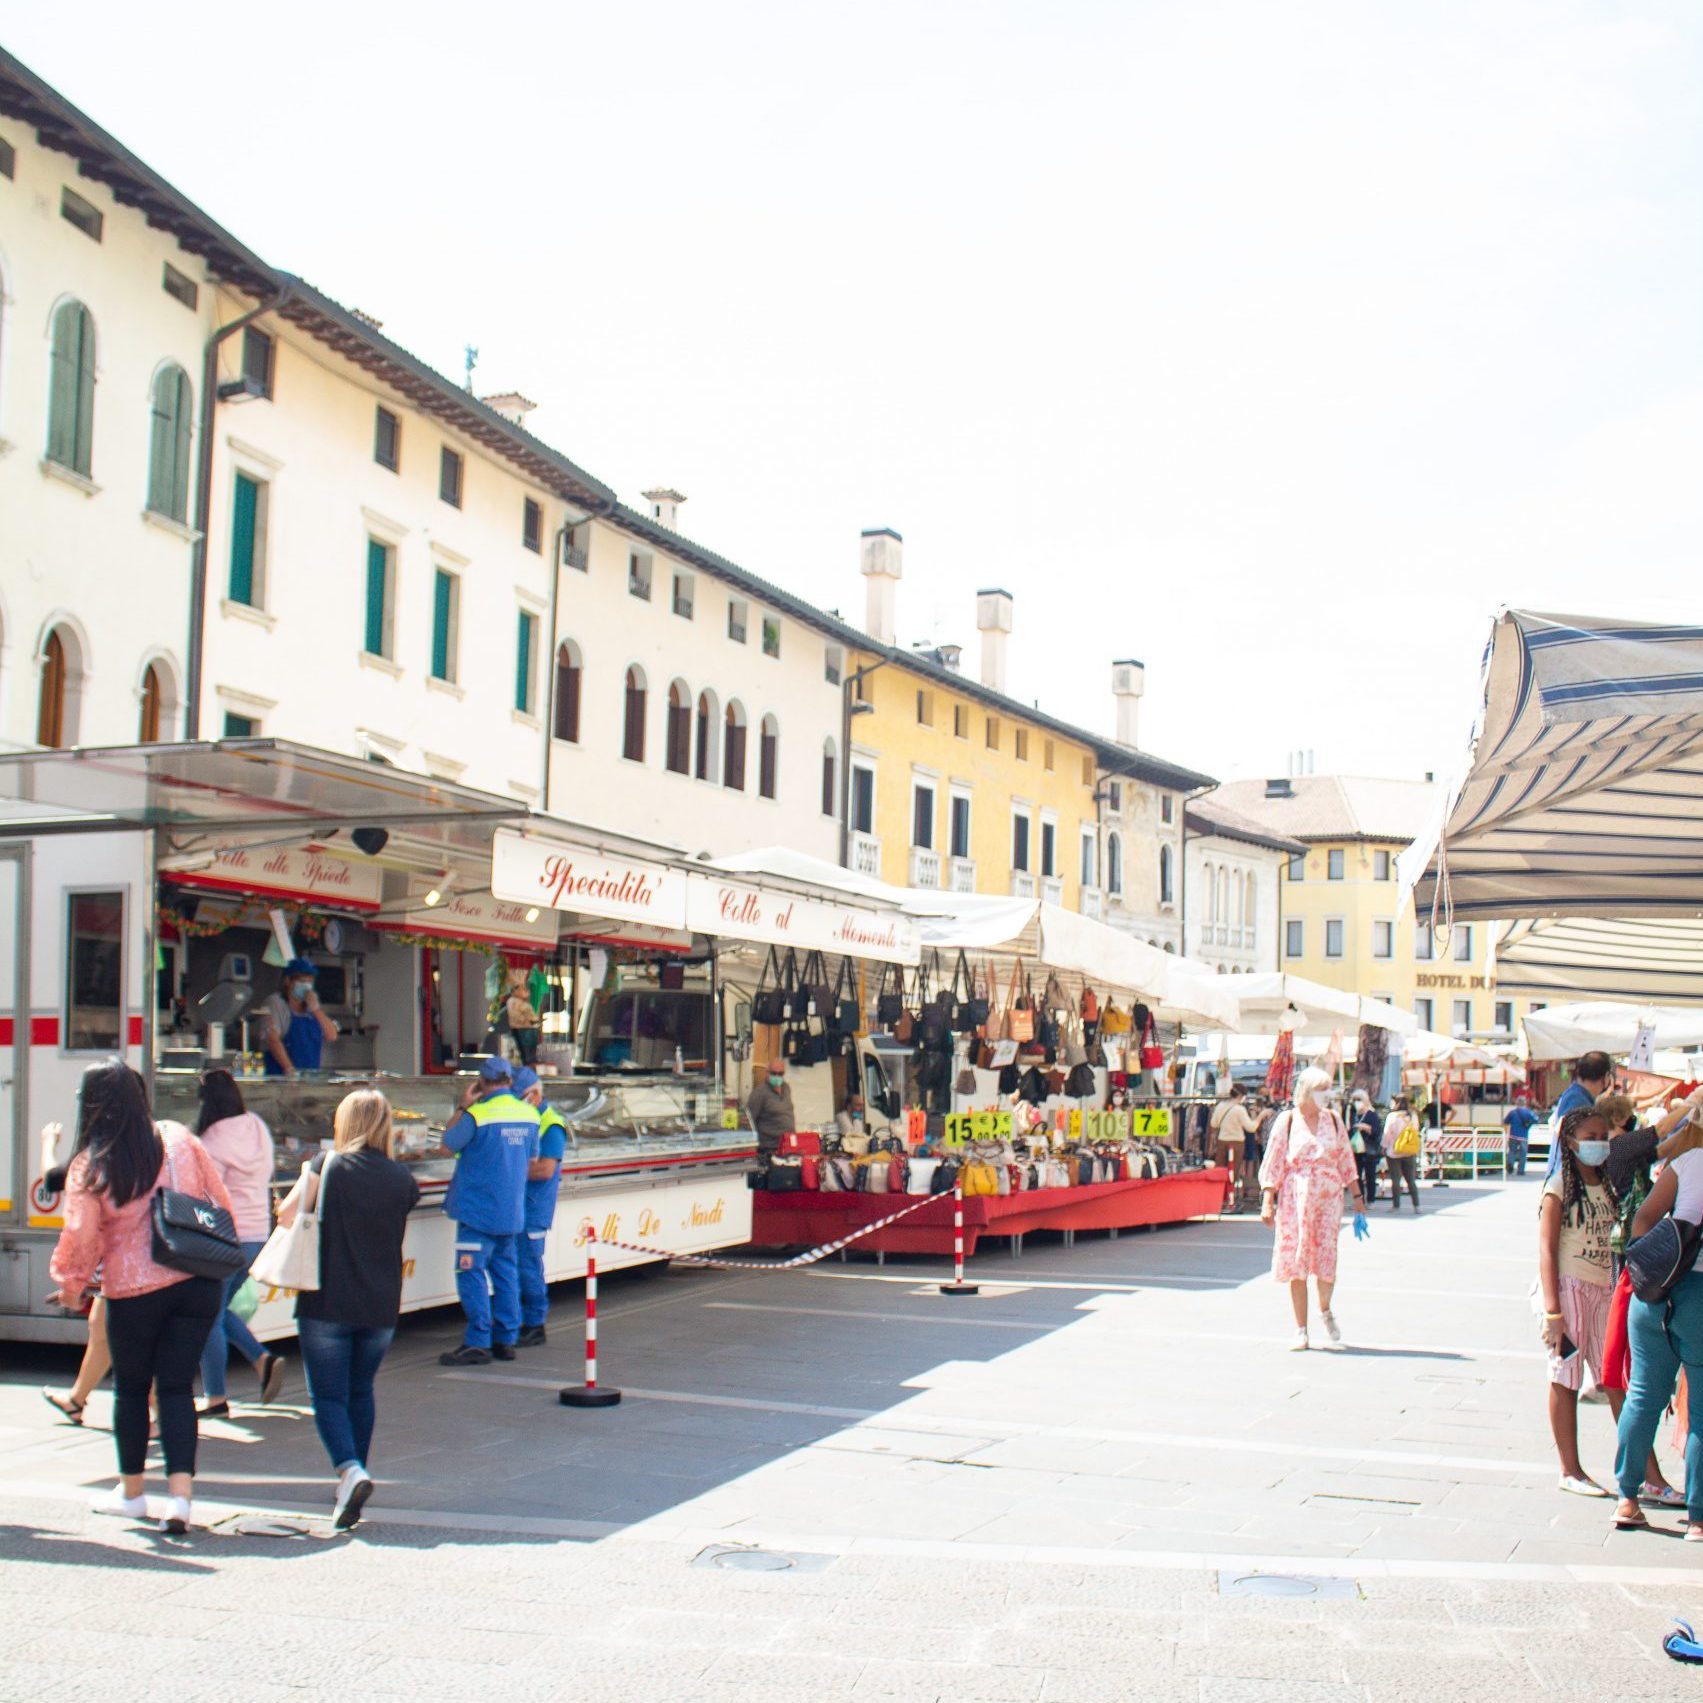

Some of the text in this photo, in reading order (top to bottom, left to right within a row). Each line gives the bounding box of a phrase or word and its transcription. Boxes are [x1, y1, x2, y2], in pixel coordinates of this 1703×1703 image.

[775, 902, 794, 930] al
[833, 914, 896, 948] Momento
[1416, 973, 1465, 988] HOTEL
[949, 1118, 972, 1142] 15
[1092, 1113, 1116, 1137] 10
[1141, 1114, 1152, 1132] 7
[194, 1207, 215, 1229] VC
[638, 1208, 660, 1237] De
[681, 1198, 725, 1230] Nardi
